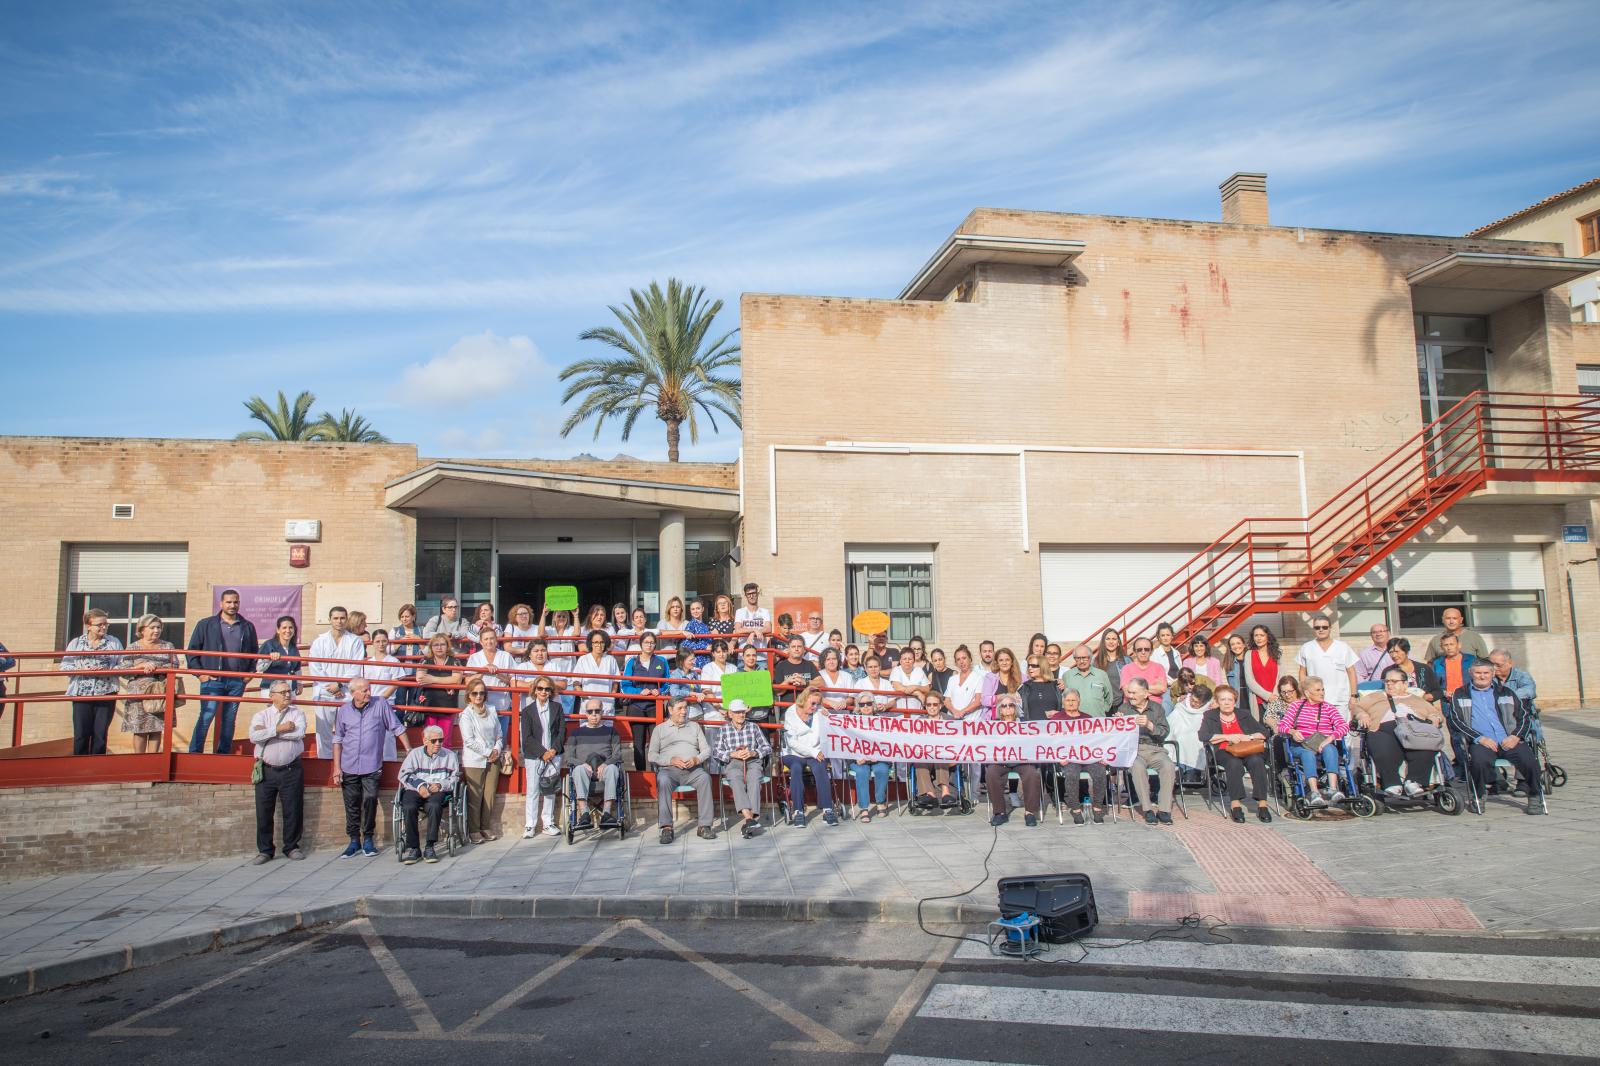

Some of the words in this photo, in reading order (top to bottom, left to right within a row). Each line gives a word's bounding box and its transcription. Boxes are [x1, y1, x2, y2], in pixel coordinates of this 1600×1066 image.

[828, 714, 858, 729] SIN
[859, 716, 958, 736] LICITACIONES
[962, 720, 1040, 736] MAYORES
[827, 734, 987, 762] TRABAJADORES/AS
[993, 746, 1028, 762] MAL
